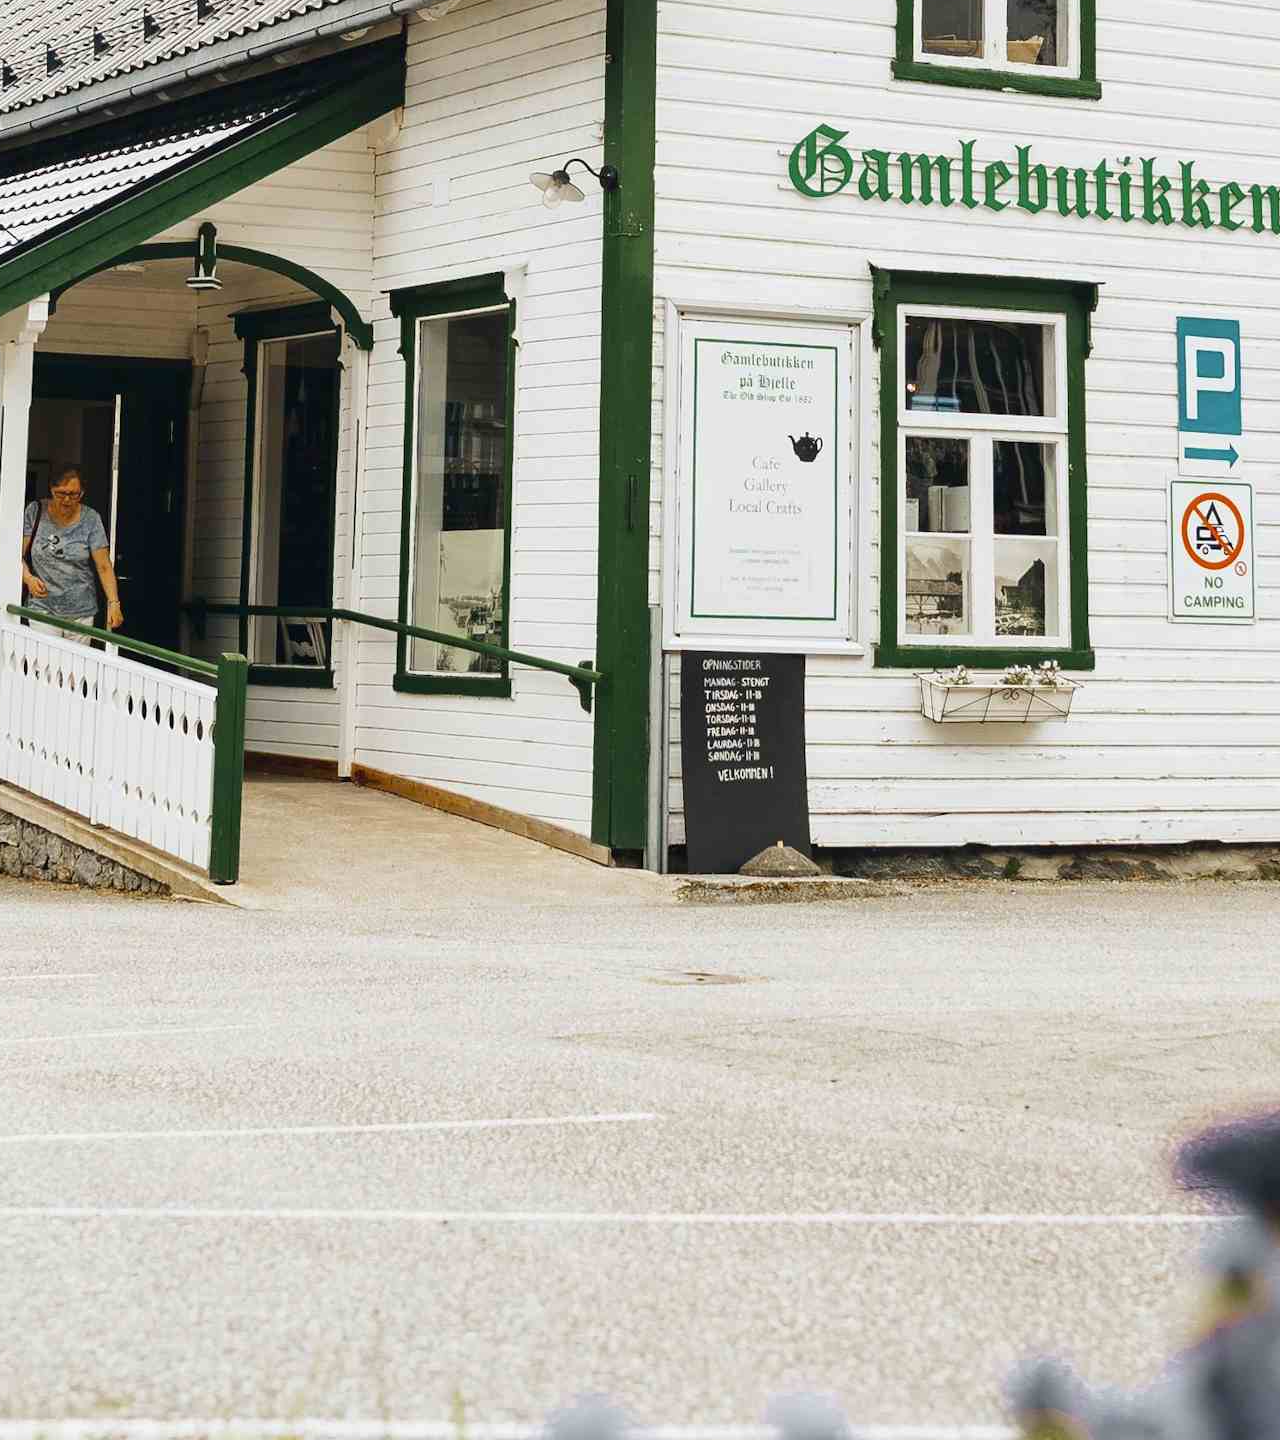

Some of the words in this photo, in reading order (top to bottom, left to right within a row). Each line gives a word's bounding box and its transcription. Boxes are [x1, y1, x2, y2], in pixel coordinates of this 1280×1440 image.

[721, 351, 815, 369] Gamlebutikken
[739, 372, 753, 388] på
[759, 374, 796, 391] Hjelle
[1184, 335, 1236, 420] P
[743, 478, 788, 496] Gallery
[728, 498, 762, 513] Local
[767, 500, 803, 514] Crafts
[1204, 576, 1224, 589] NO
[1184, 595, 1245, 609] CAMPING
[702, 659, 761, 671] OPNINGSTIDER
